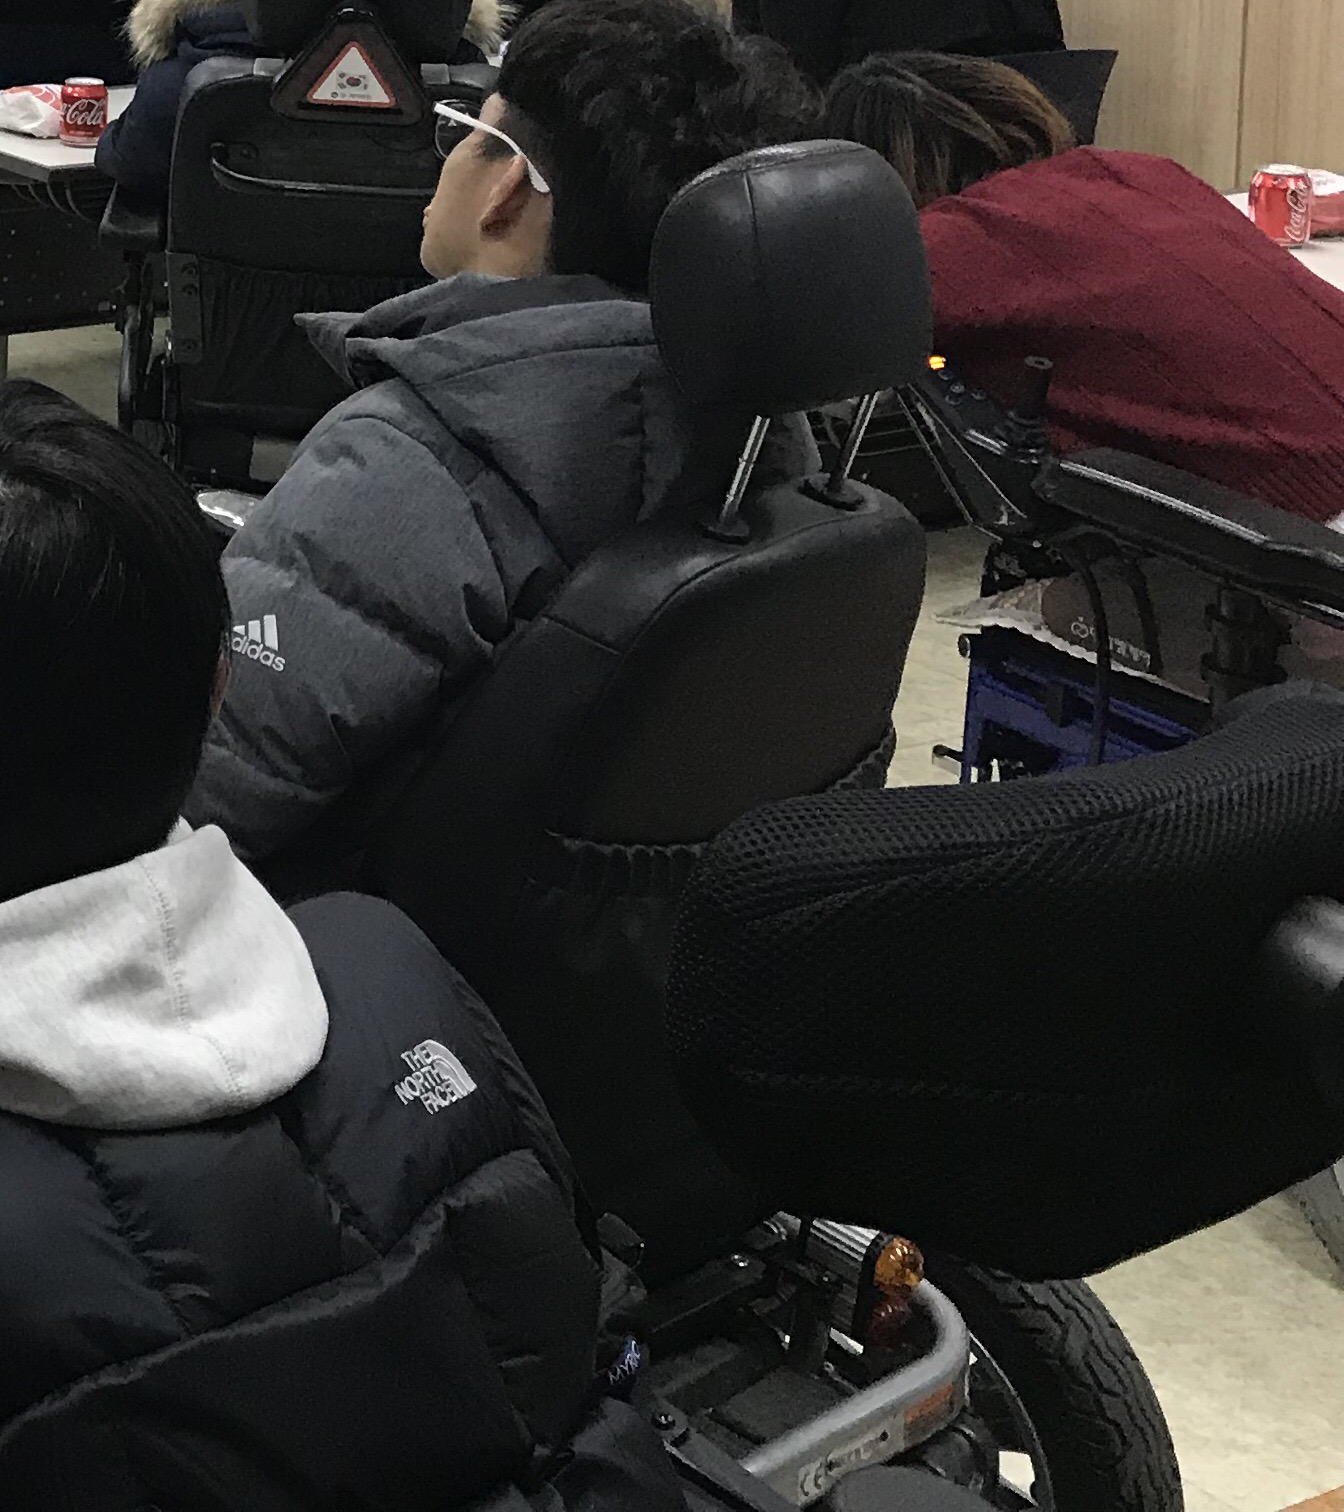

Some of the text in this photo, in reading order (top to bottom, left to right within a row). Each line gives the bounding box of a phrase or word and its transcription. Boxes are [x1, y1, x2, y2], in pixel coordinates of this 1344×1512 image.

[226, 635, 286, 672] didas
[401, 1044, 433, 1072] THE
[394, 1064, 445, 1105] NORTH
[419, 1080, 461, 1115] FACE
